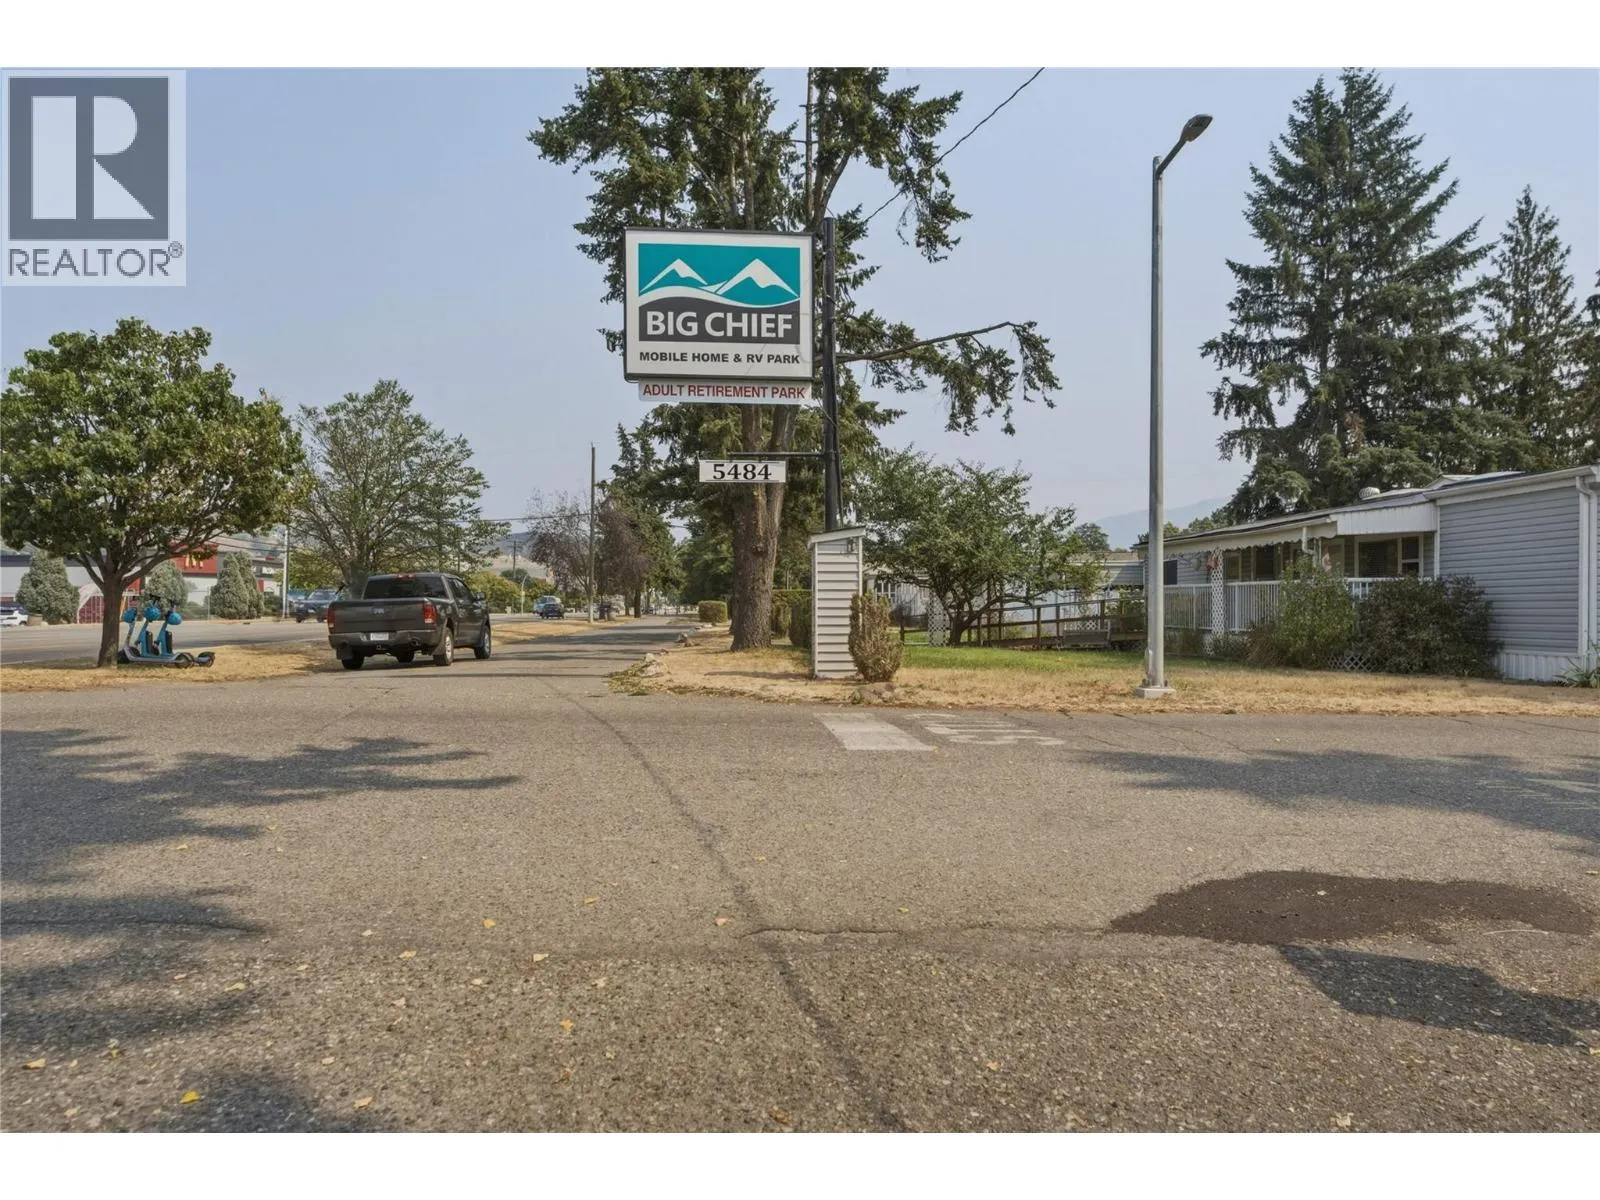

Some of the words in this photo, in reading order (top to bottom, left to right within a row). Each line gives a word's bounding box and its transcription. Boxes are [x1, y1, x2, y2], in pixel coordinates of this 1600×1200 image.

[646, 310, 698, 336] BIG
[704, 311, 793, 338] CHIEF
[639, 351, 688, 362] MOBILE
[692, 352, 729, 363] HOME
[733, 353, 742, 363] &
[746, 353, 763, 363] RV
[767, 354, 800, 364] PARK
[643, 384, 684, 396] ADULT
[687, 384, 768, 398] RETIREMENT
[771, 386, 806, 399] PARK
[712, 463, 772, 480] 5484
